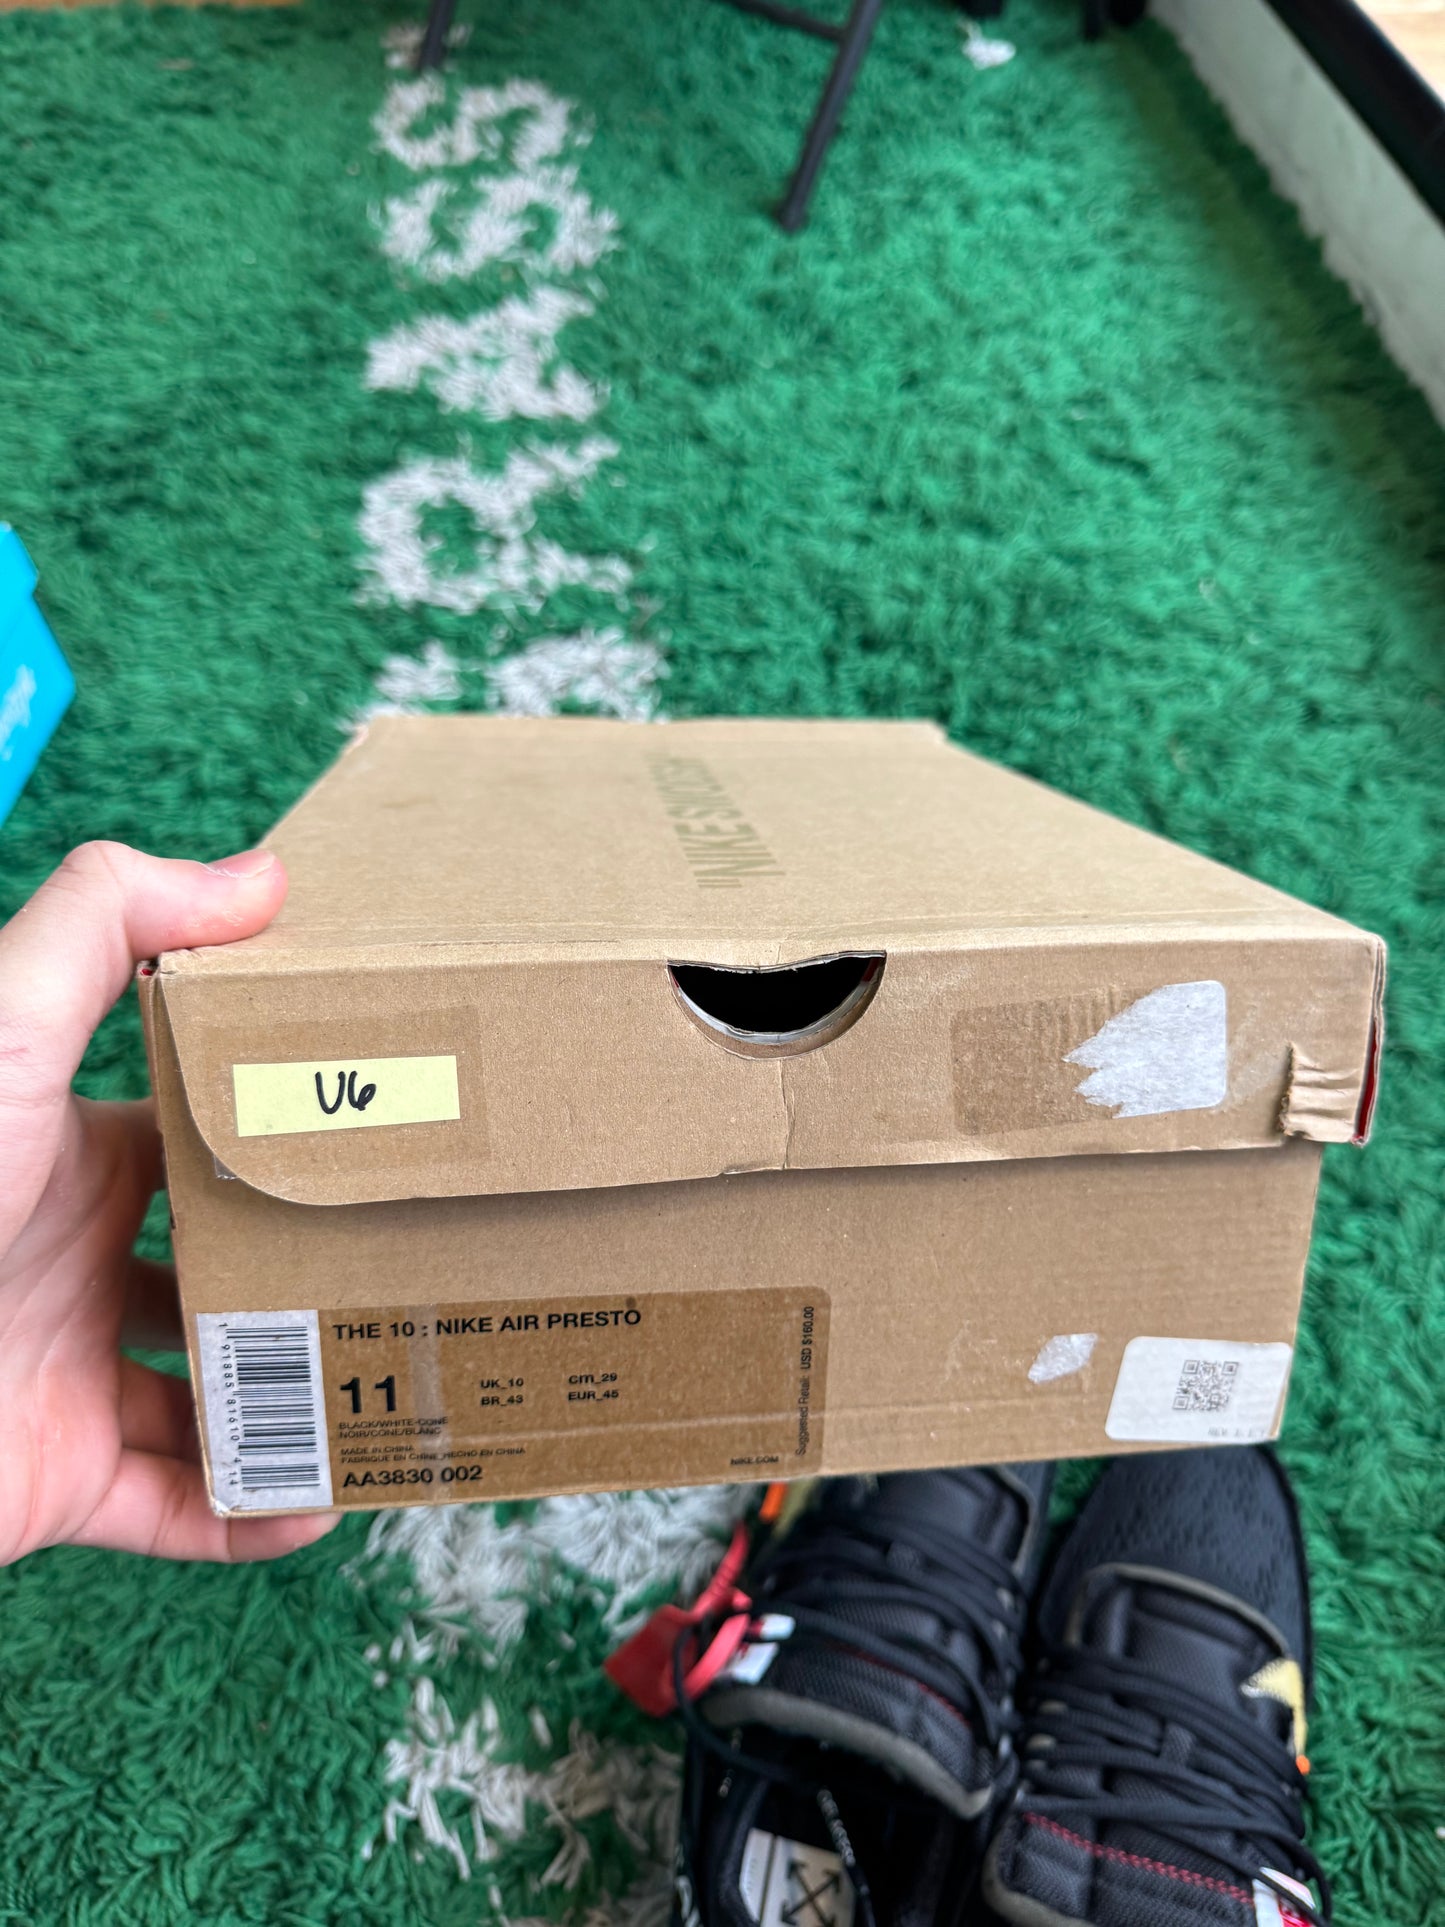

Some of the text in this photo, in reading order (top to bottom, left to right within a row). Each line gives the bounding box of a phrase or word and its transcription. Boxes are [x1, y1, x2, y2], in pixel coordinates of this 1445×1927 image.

[332, 1322, 382, 1340] THE
[389, 1321, 415, 1337] 10
[436, 1316, 493, 1335] NIKE
[500, 1314, 540, 1332] AIR
[547, 1309, 642, 1329] PRESTO
[803, 1306, 815, 1345] $160.00
[801, 1347, 813, 1371] USD
[340, 1374, 397, 1414] 11
[480, 1377, 525, 1390] UK_10
[481, 1389, 619, 1407] BR_43 EUR_45
[342, 1464, 483, 1488] AA3830 002
